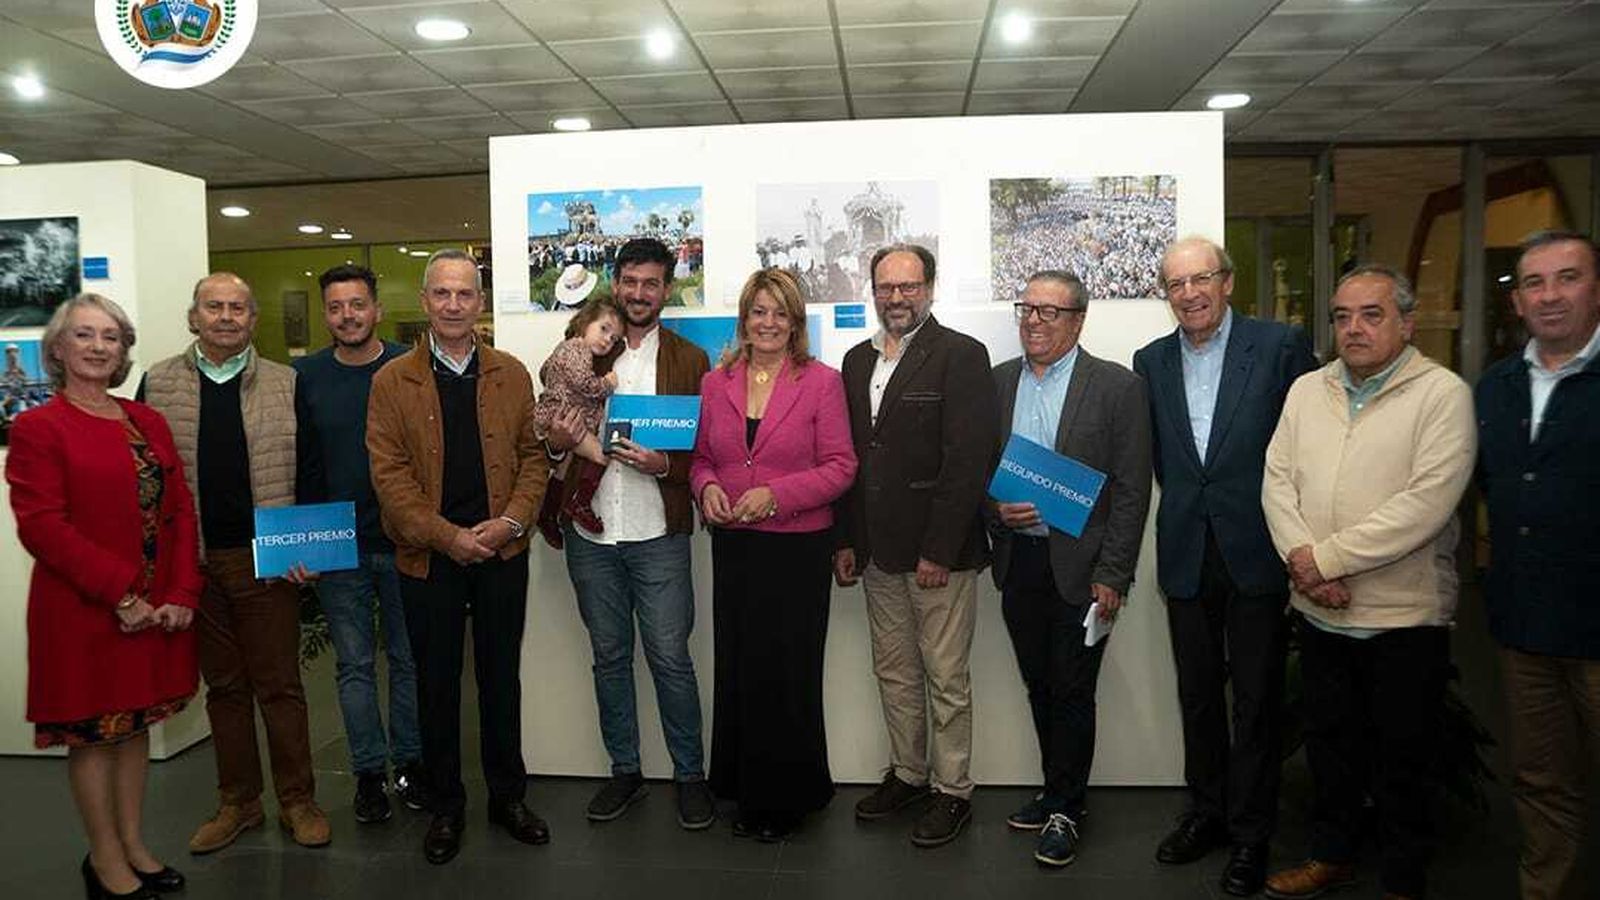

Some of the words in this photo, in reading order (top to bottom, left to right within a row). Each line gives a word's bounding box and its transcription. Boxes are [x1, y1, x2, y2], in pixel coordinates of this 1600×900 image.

[651, 417, 696, 429] PREMIO
[1000, 459, 1052, 489] SEGUNDO
[1052, 482, 1094, 508] PREMIO
[257, 533, 307, 546] TERCER
[308, 528, 356, 542] PREMIO
